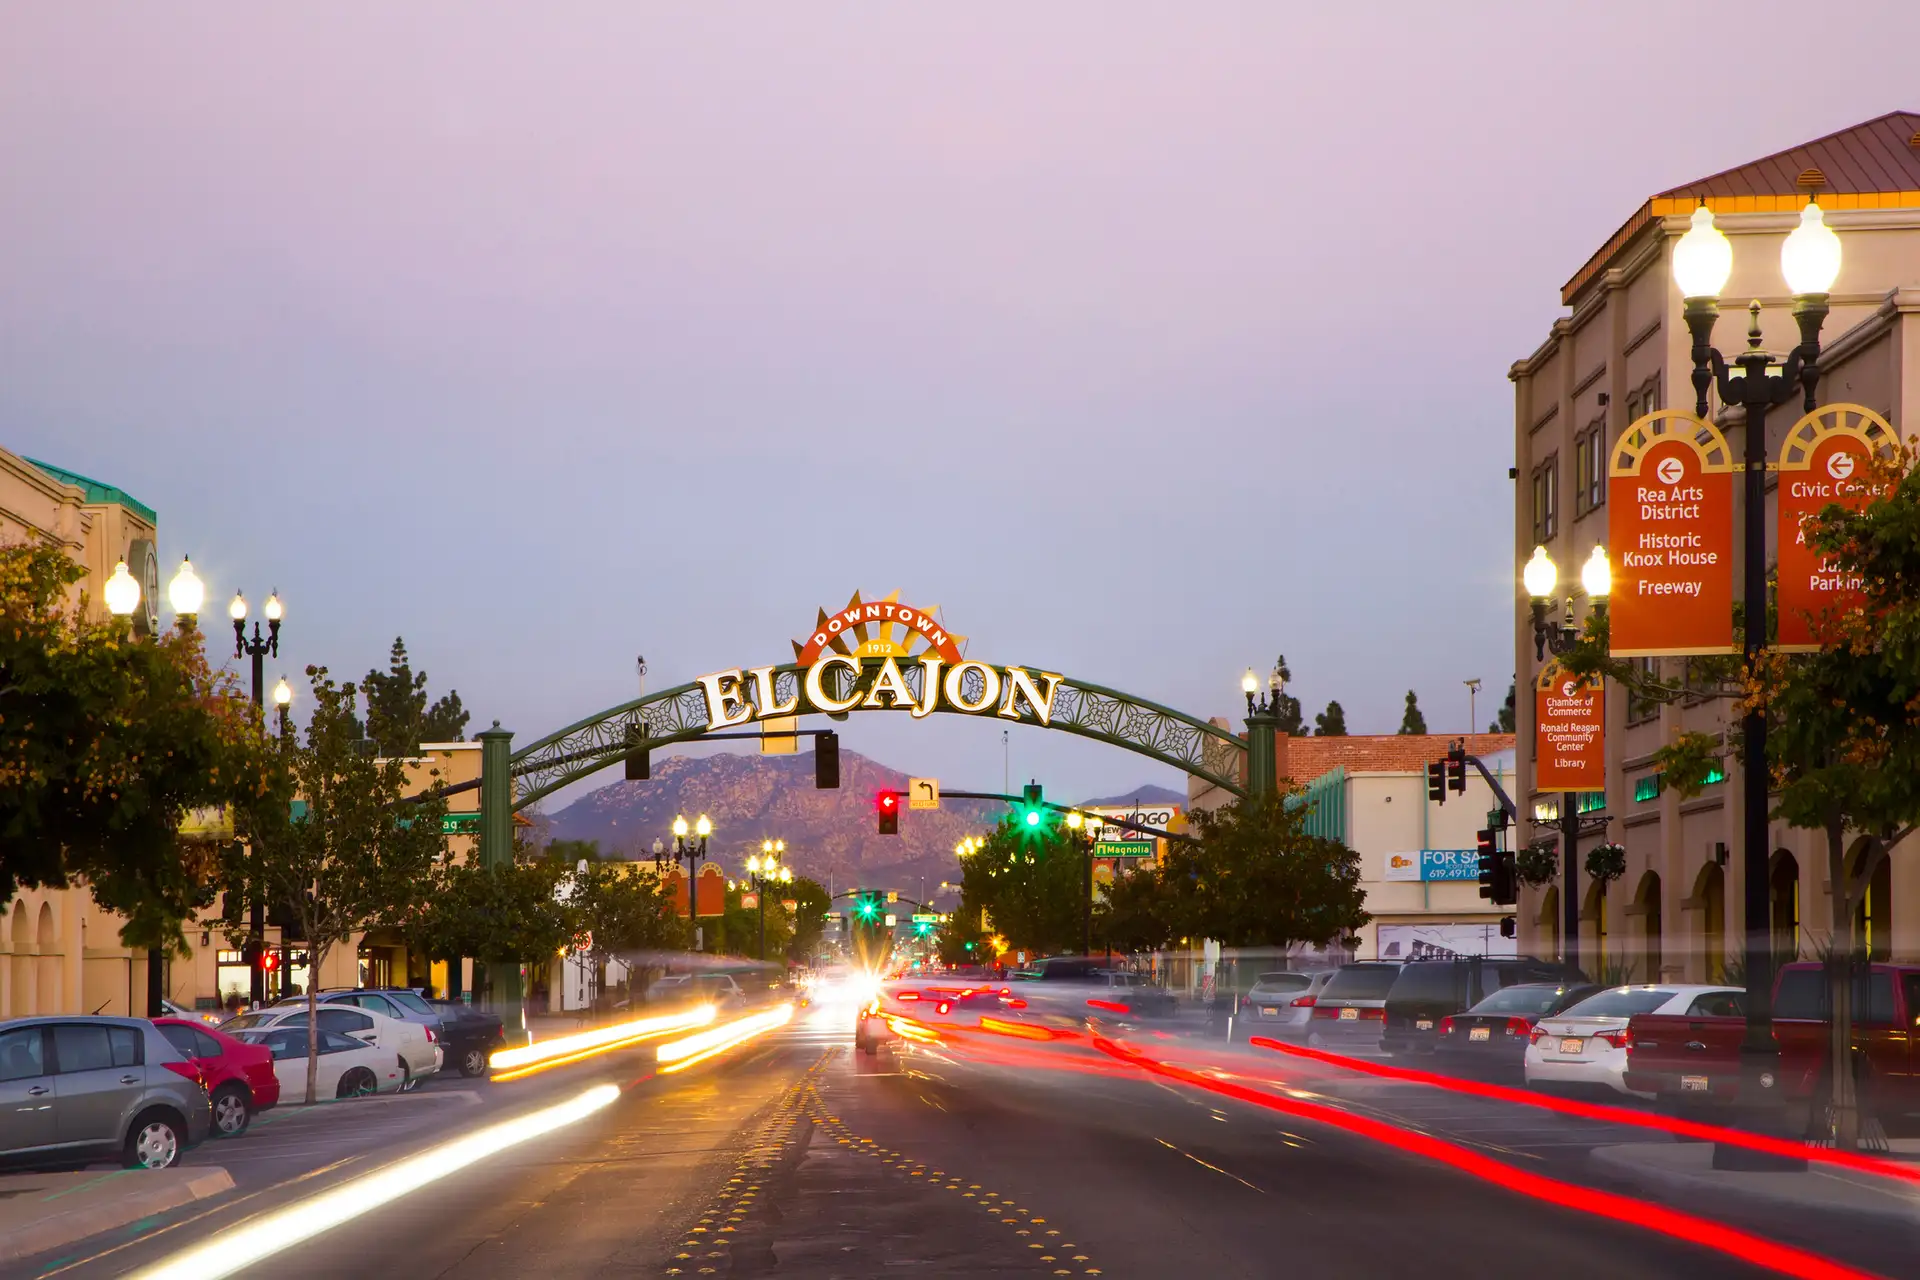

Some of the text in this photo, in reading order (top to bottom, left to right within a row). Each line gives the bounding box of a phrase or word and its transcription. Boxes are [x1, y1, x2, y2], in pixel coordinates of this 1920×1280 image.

[1637, 486, 1704, 502] Rea Arts
[1791, 482, 1830, 498] Civic
[1641, 504, 1700, 520] District
[1639, 532, 1702, 549] Historic
[1623, 550, 1718, 567] Knox House
[1638, 580, 1703, 597] Freeway
[813, 604, 947, 647] DOWNTOWN
[867, 644, 892, 653] 1912
[697, 655, 1064, 732] EL CAJON
[1546, 697, 1594, 707] Chamber of
[1547, 707, 1592, 717] Commerce
[1541, 723, 1600, 734] Ronald Reagan
[1547, 733, 1594, 743] Community
[1556, 742, 1585, 752] Center
[1554, 759, 1586, 770] Library
[1107, 845, 1150, 856] Magnolia
[1423, 851, 1457, 864] FOR
[1460, 851, 1481, 864] SA
